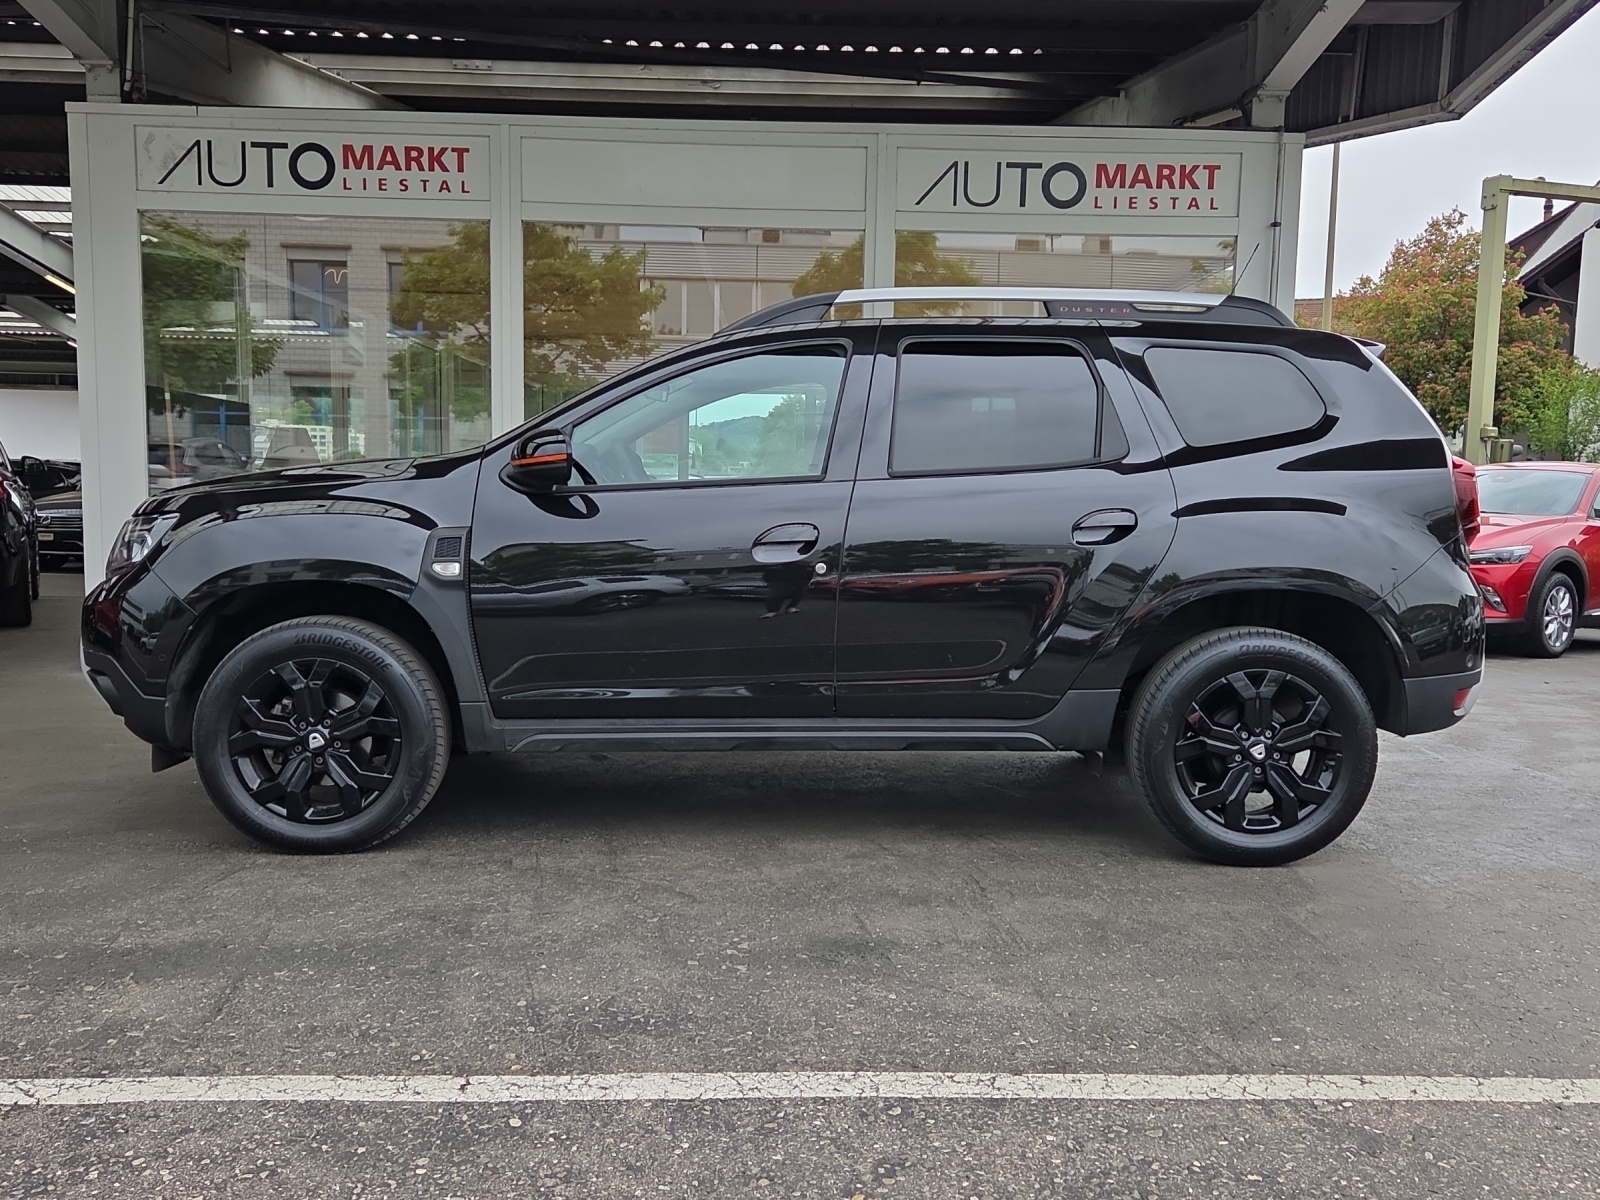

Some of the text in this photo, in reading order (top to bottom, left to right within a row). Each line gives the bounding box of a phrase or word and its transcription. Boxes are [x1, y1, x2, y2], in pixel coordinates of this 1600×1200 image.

[157, 139, 470, 190] AUTO MARKT
[342, 177, 471, 194] LIESTAL
[914, 160, 1221, 210] AUTO MARKT
[1093, 196, 1219, 211] LIESTAL
[1060, 306, 1131, 314] DUSTER
[294, 633, 393, 673] BRIDGESTONE
